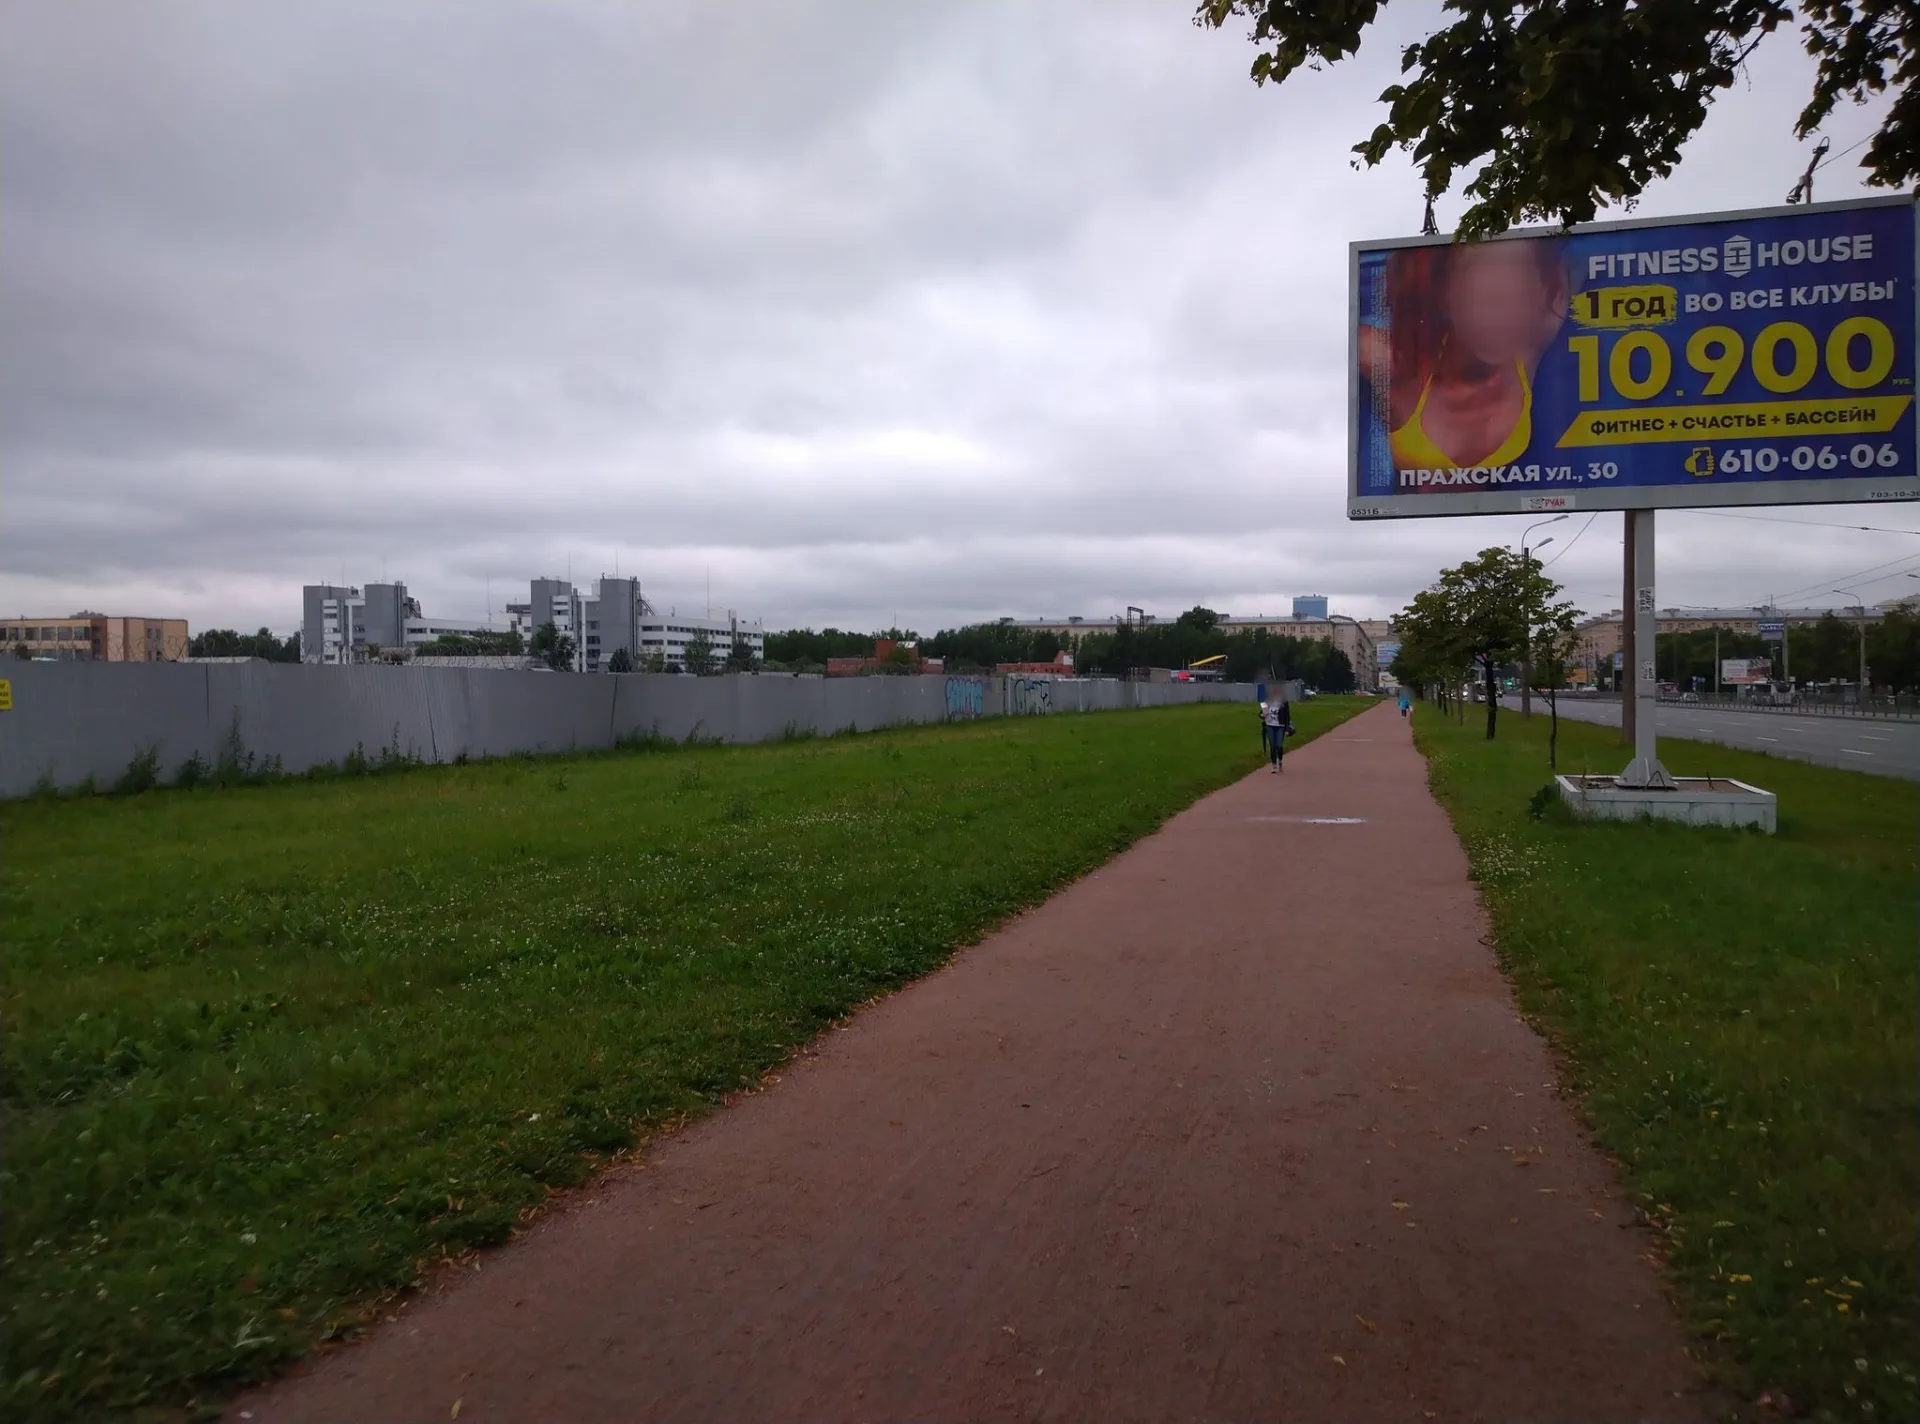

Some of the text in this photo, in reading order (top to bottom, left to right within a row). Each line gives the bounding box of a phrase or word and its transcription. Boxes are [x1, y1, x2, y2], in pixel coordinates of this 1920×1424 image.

[1588, 234, 1873, 280] FITNESS HOUSE
[1586, 291, 1599, 319] 1
[1685, 293, 1723, 313] ВО
[1730, 288, 1783, 311] ВСЕ
[1568, 316, 1895, 402] 10.900
[1590, 418, 1664, 436] ФИТНЕС
[1682, 413, 1767, 430] СЧАСТЬЕ
[1785, 407, 1877, 426] БАССЕЙН
[1719, 443, 1899, 474] 610-06-06
[1400, 465, 1540, 487] ПРАЖСКАЯ
[1588, 462, 1619, 480] 30
